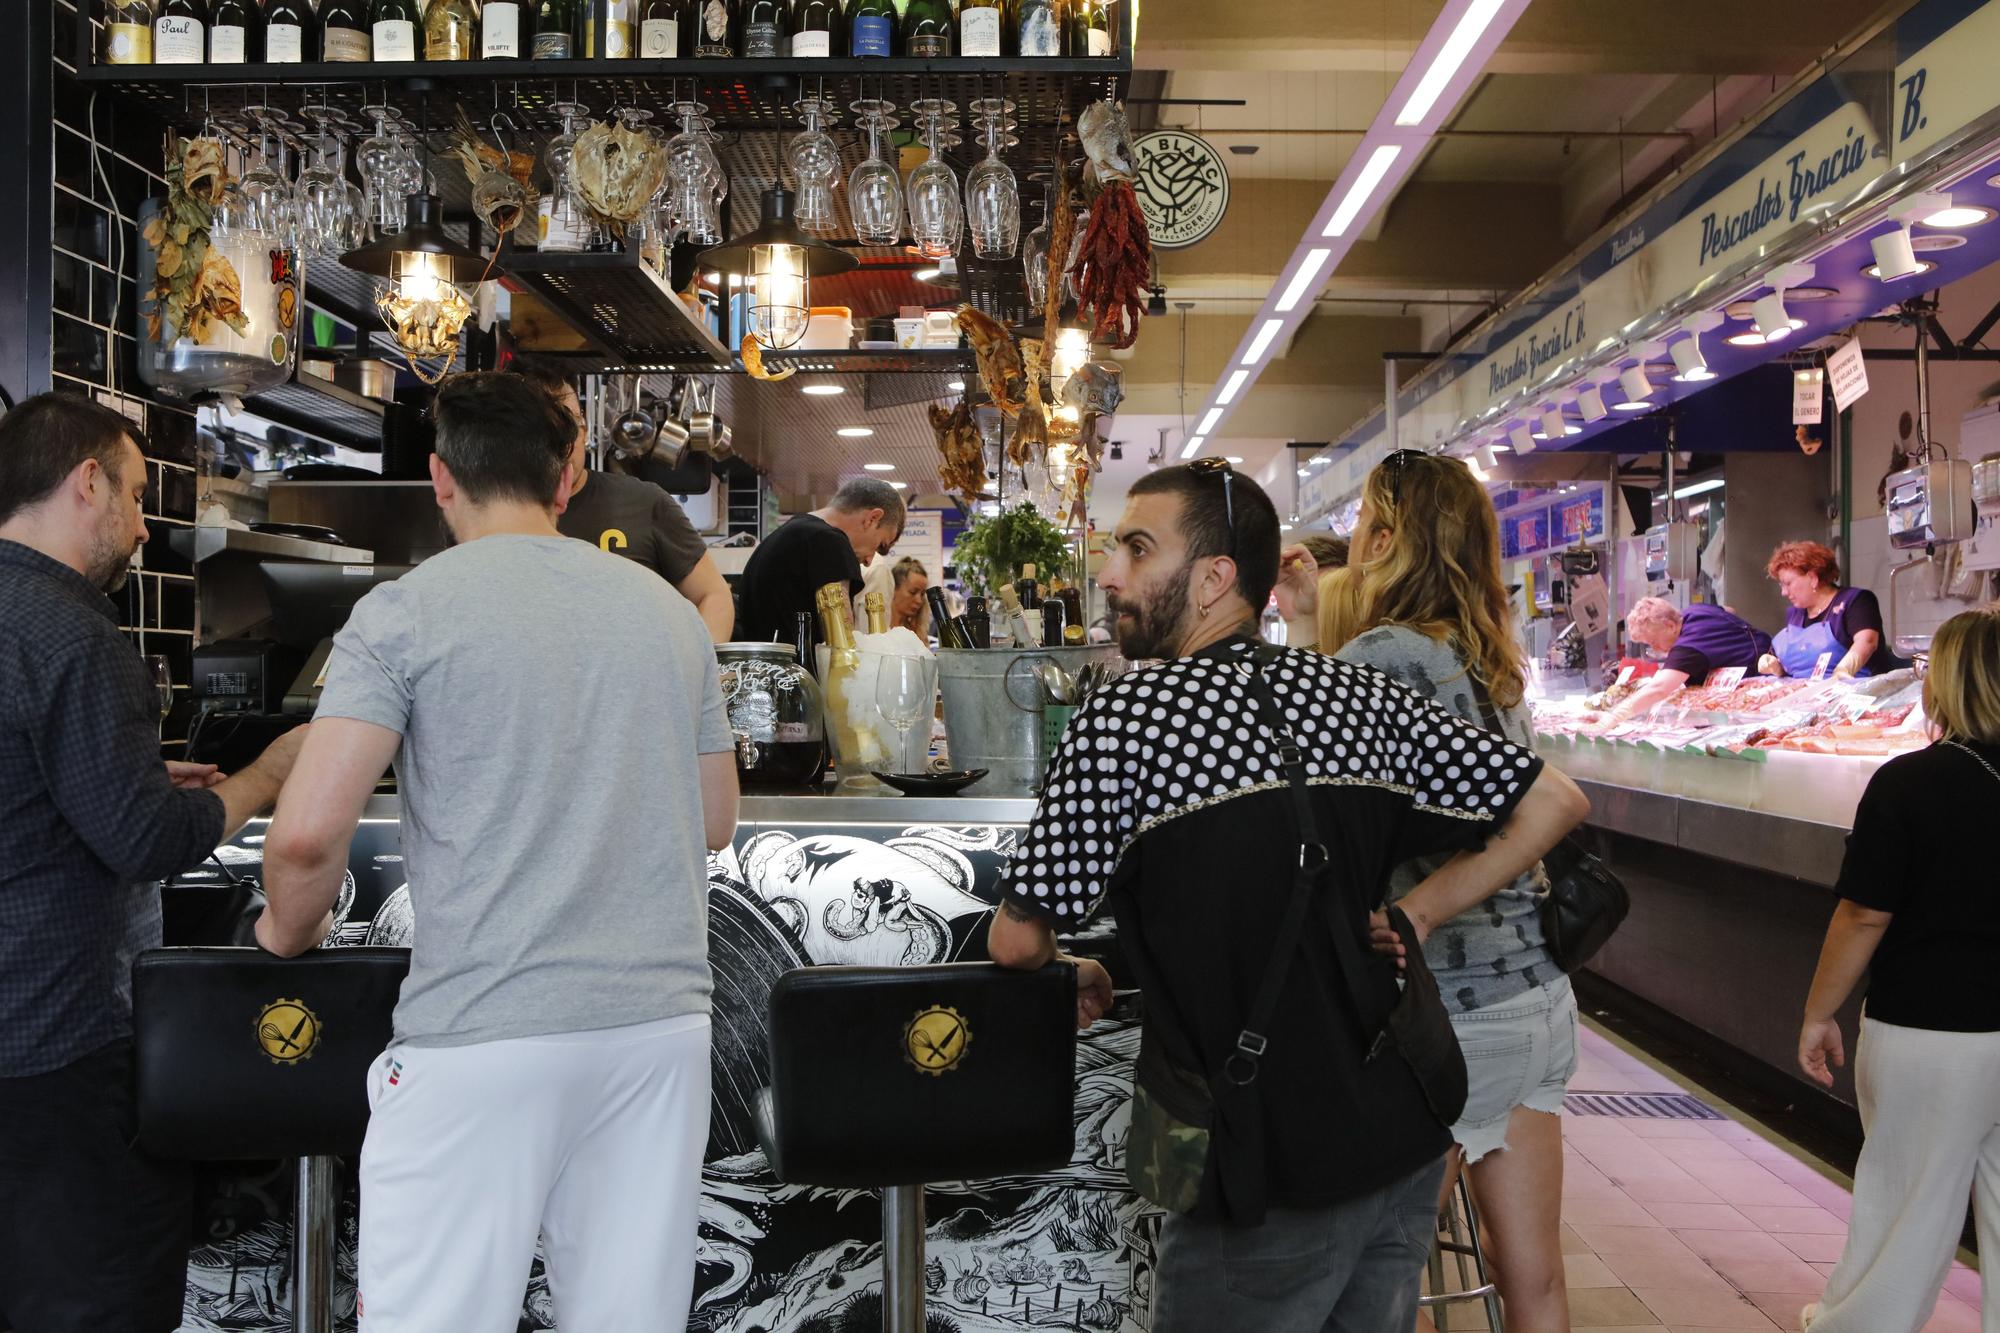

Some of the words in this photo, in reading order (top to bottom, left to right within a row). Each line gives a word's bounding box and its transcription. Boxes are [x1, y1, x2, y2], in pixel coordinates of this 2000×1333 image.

[162, 19, 190, 35] Paul
[696, 46, 734, 58] SILEX
[912, 44, 942, 53] KRUG
[1158, 138, 1220, 194] BLANCA
[1699, 176, 1785, 266] Pescados
[1786, 126, 1867, 223] Gracia
[1899, 68, 1927, 143] B.
[1489, 346, 1527, 397] Pescados
[1528, 326, 1561, 380] Gracia
